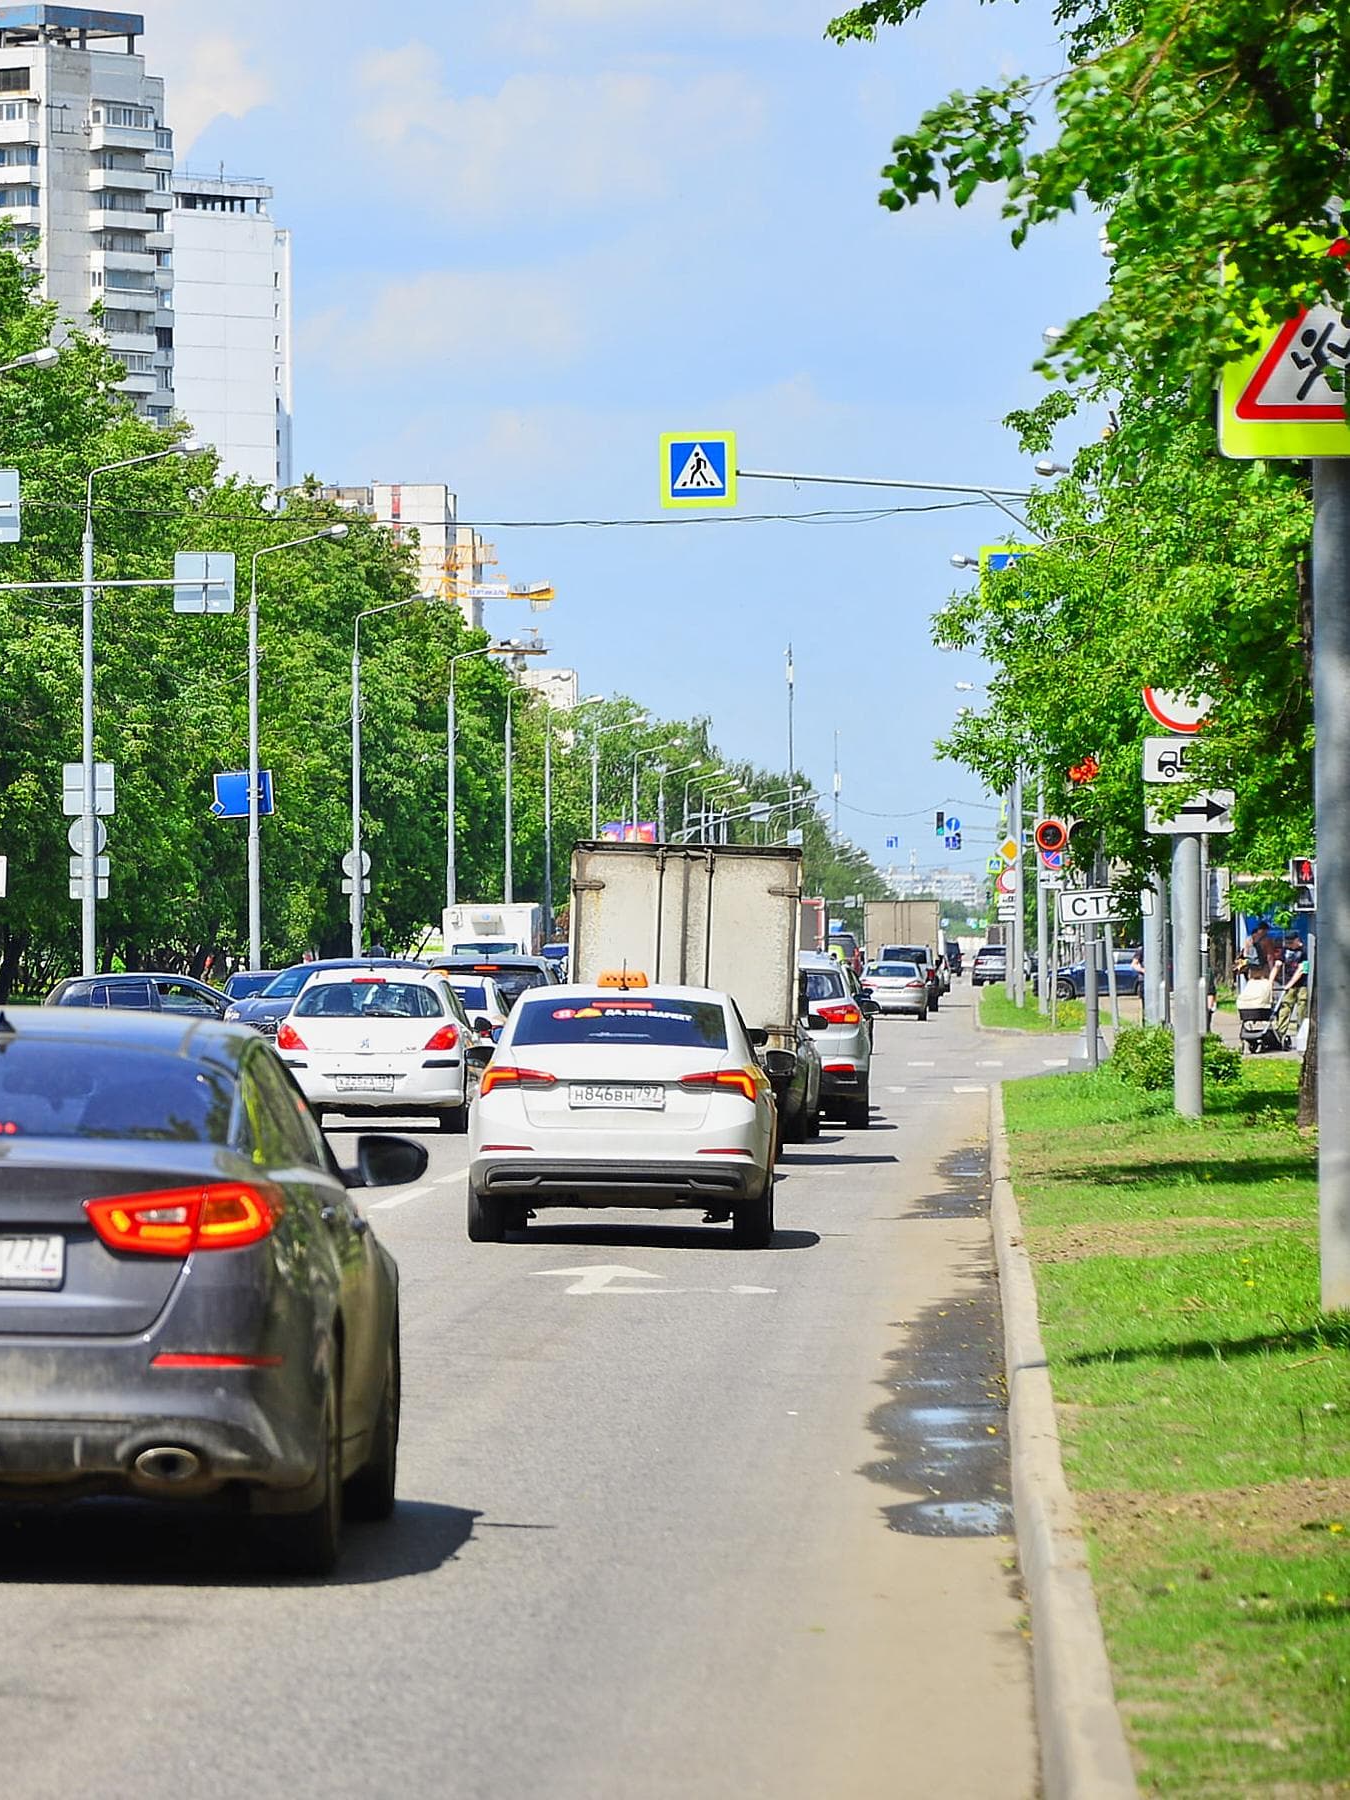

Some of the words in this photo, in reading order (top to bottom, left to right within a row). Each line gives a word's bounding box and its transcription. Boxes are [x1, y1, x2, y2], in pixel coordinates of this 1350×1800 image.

[1071, 896, 1119, 916] СТ
[574, 1086, 634, 1101] Н846ВН
[636, 1086, 659, 1099] 797
[2, 1238, 51, 1262] 777
